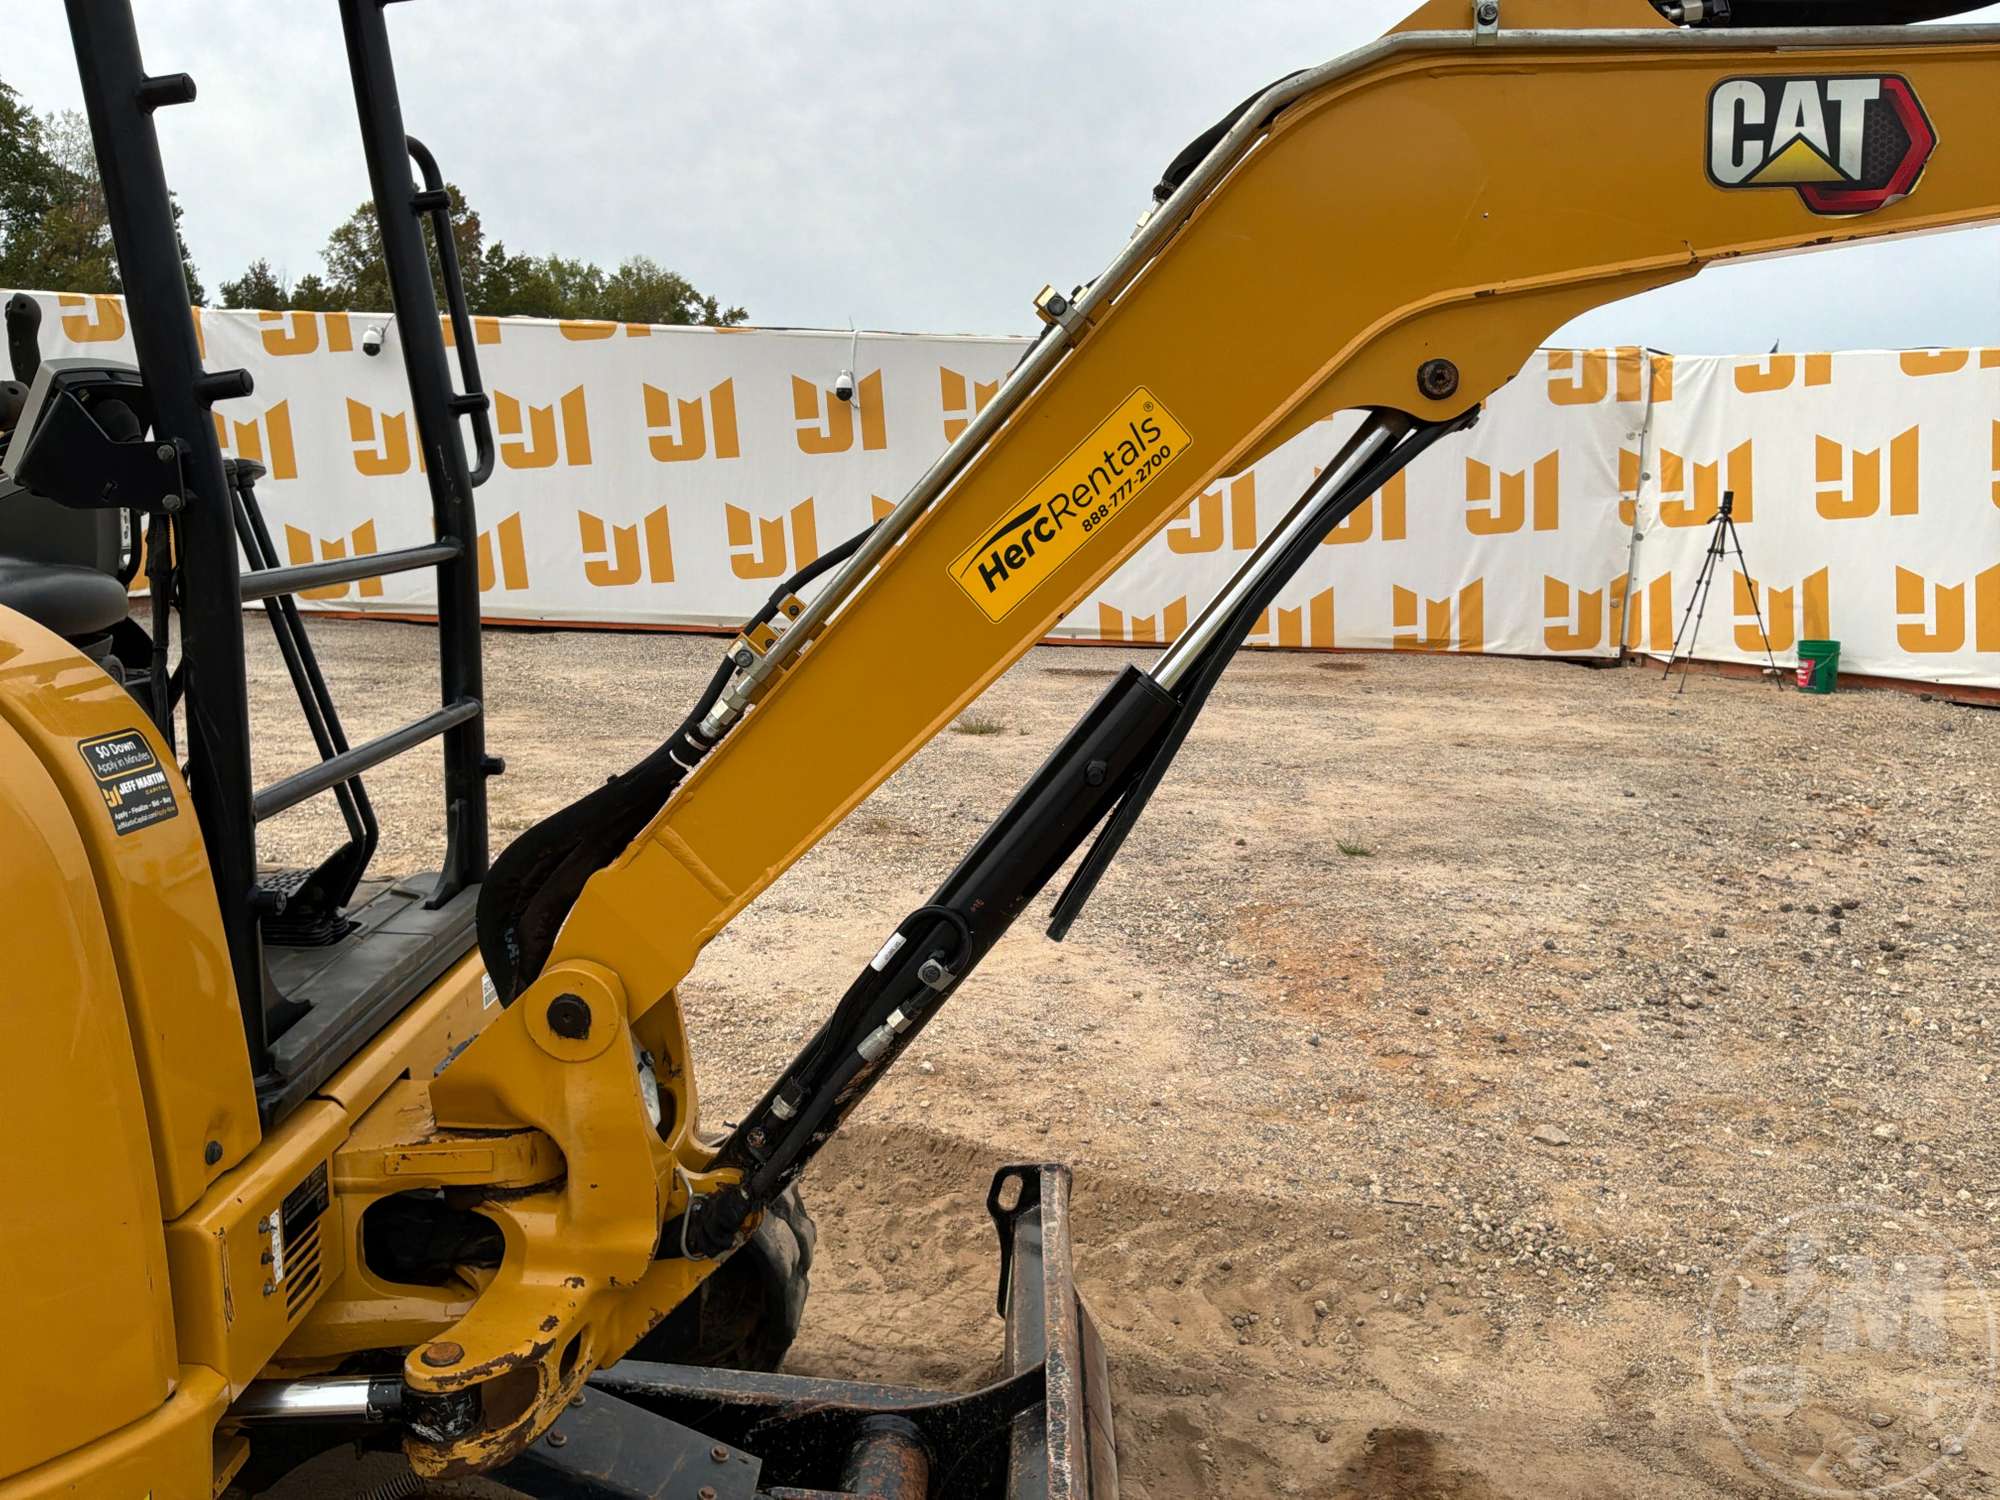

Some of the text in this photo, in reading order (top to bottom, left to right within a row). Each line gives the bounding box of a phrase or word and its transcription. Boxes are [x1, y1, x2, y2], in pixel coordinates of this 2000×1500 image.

[1711, 79, 1880, 184] CAT
[1082, 445, 1171, 533] 888-777-2700
[109, 741, 137, 755] Down
[119, 771, 166, 795] JEFF MARTIN
